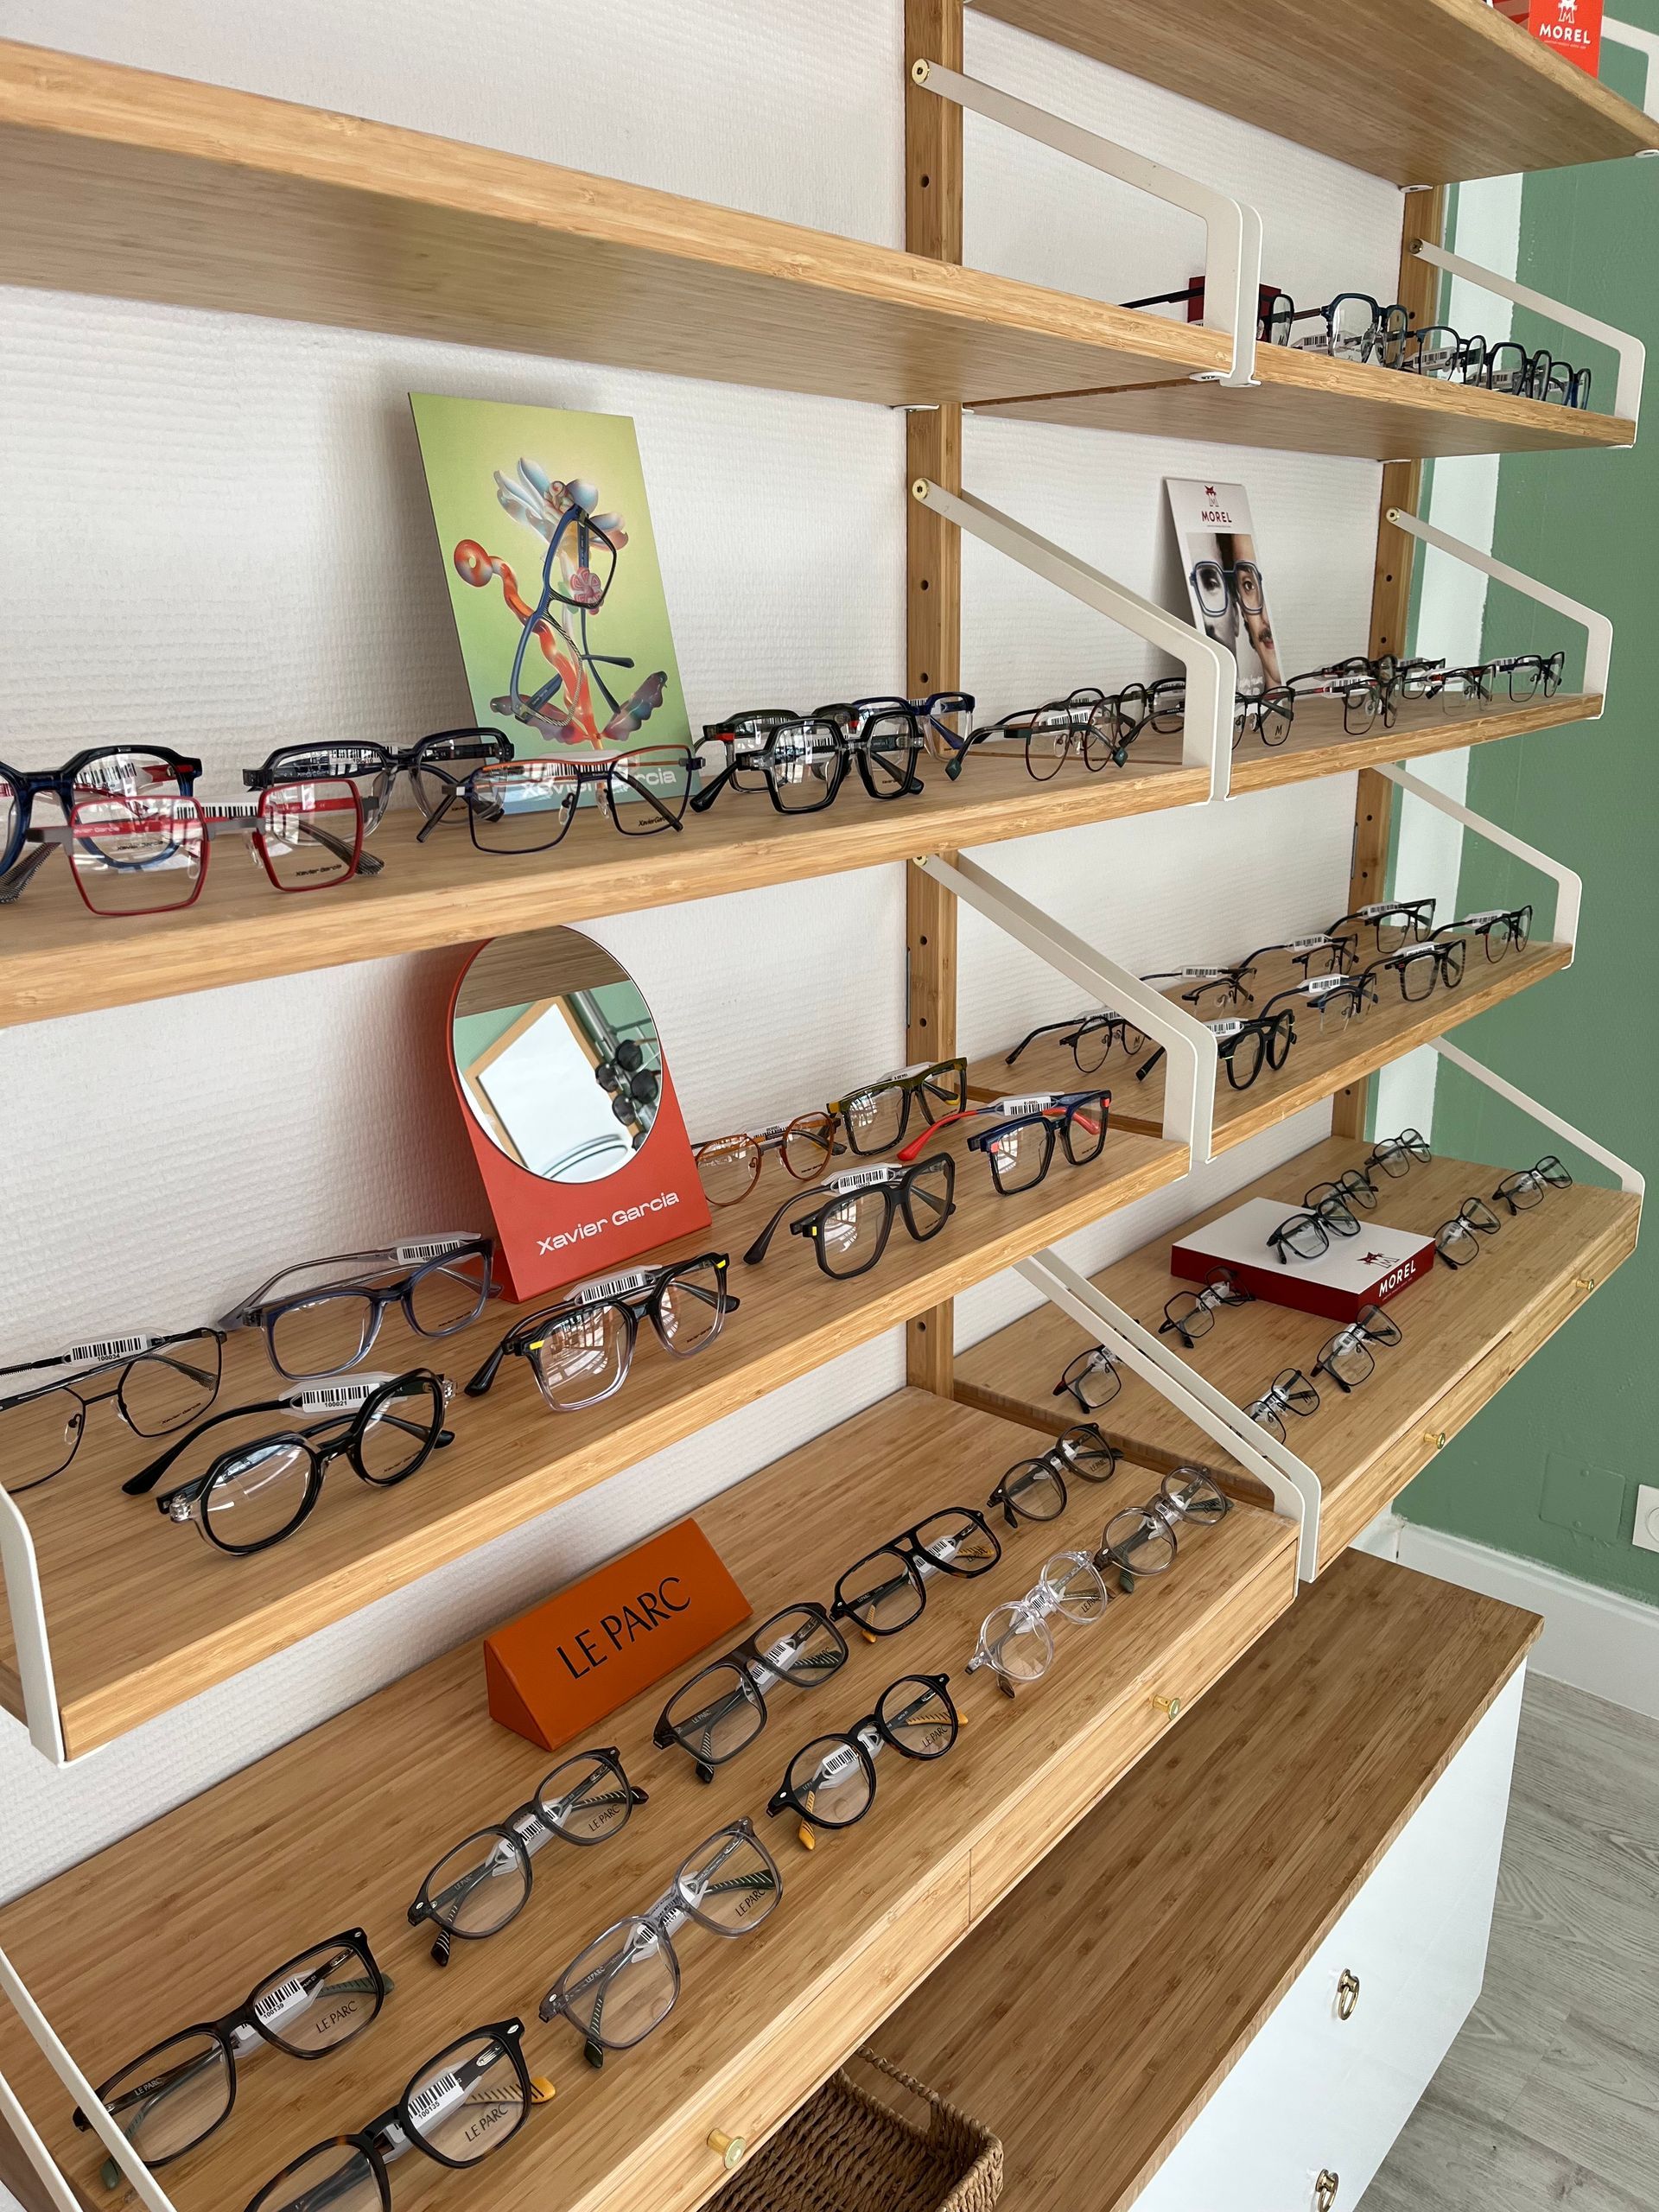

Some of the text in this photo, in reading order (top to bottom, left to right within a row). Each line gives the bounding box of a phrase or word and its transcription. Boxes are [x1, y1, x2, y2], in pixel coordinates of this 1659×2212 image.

[1539, 22, 1592, 44] MOREL
[1201, 511, 1232, 523] MOREL
[536, 1192, 680, 1255] Xavier Garcia
[1378, 1260, 1416, 1297] MOREL
[97, 1353, 121, 1362] 100034
[556, 1576, 690, 1680] LE PARC
[692, 1708, 712, 1725] LE PARC
[921, 1725, 948, 1748] LE PARC
[588, 1803, 622, 1832] LE PARC
[734, 1889, 766, 1917] LE PARC
[585, 1966, 605, 1984] LE PARC
[263, 2002, 285, 2019] 100139
[315, 2000, 358, 2034] LE PARC
[134, 2077, 164, 2096] LE PARC
[418, 2101, 441, 2120] 100135
[464, 2103, 509, 2143] LE PARC
